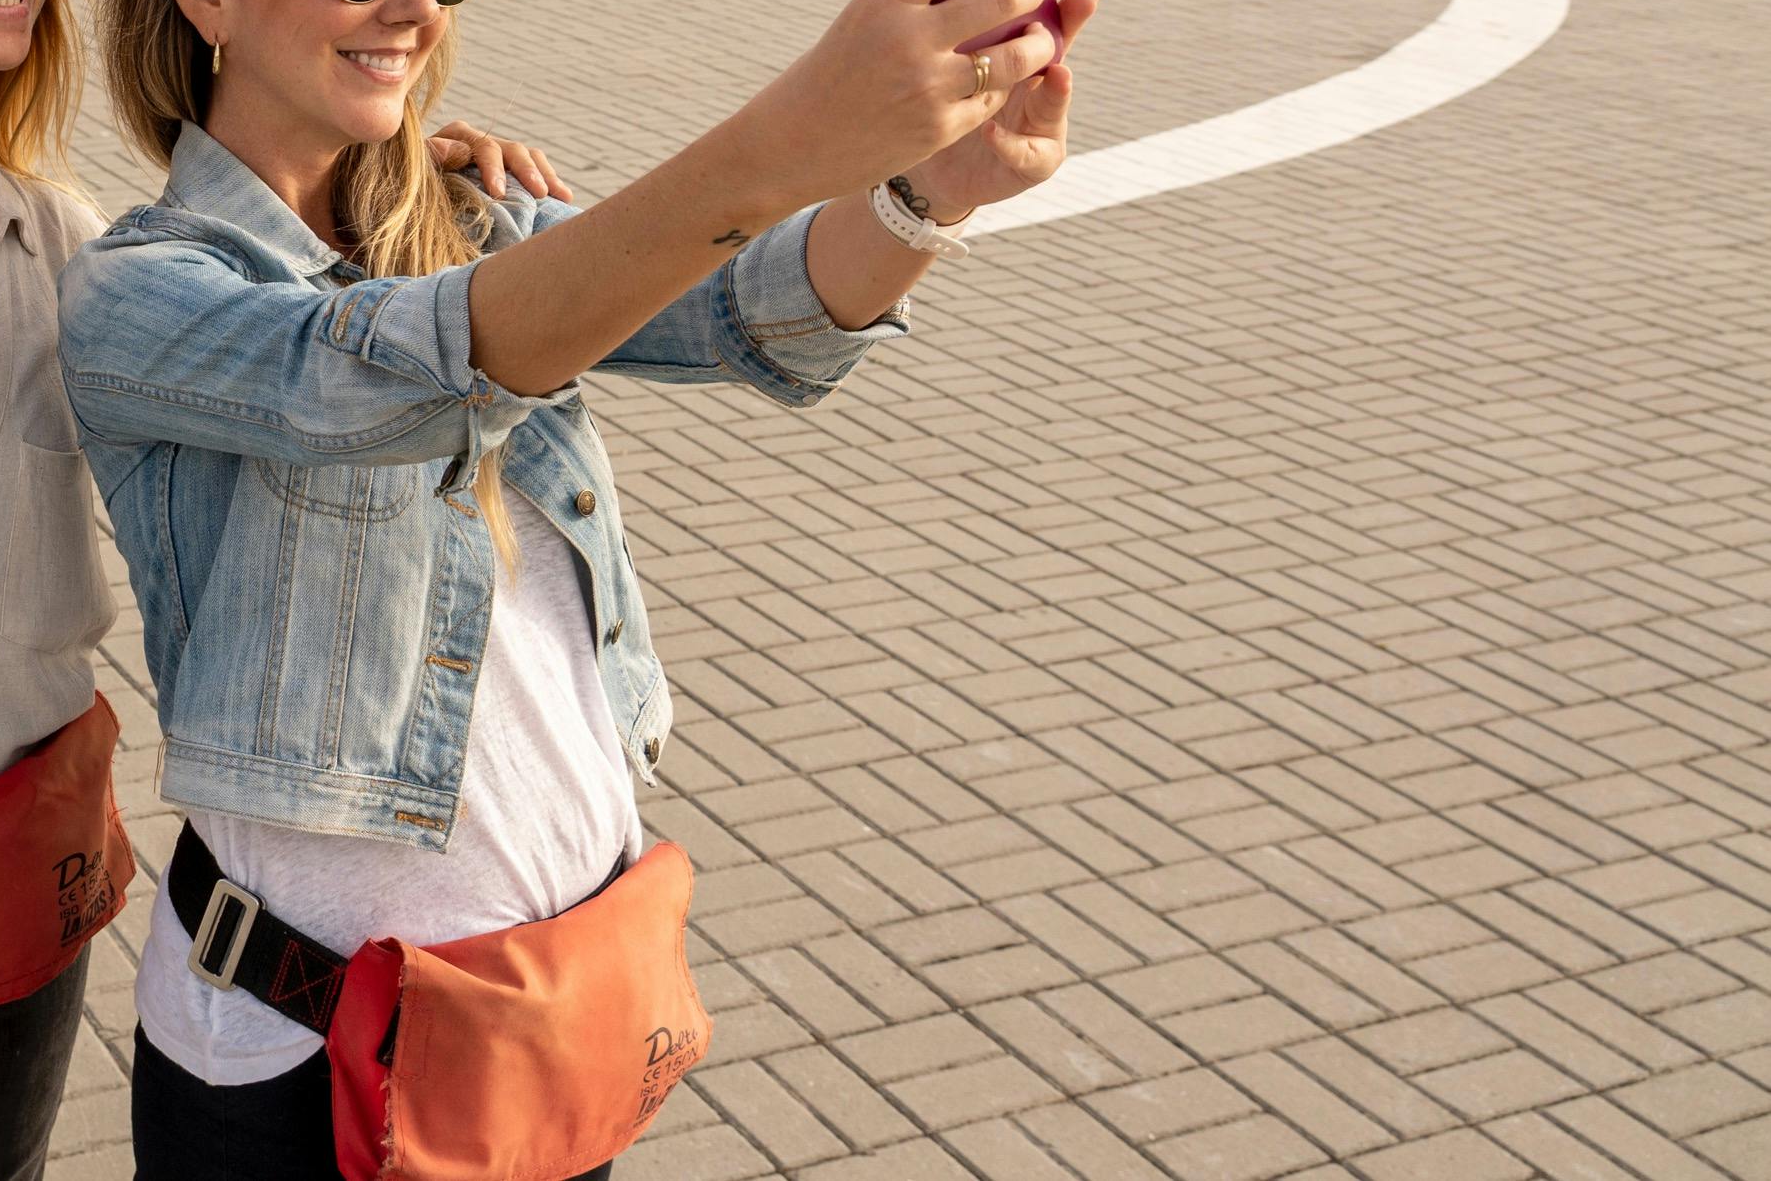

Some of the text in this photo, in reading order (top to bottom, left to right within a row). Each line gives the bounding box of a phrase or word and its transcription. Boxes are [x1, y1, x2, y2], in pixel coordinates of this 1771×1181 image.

[59, 887, 77, 906] CE
[643, 1065, 661, 1083] CE
[640, 1083, 659, 1098] ISO
